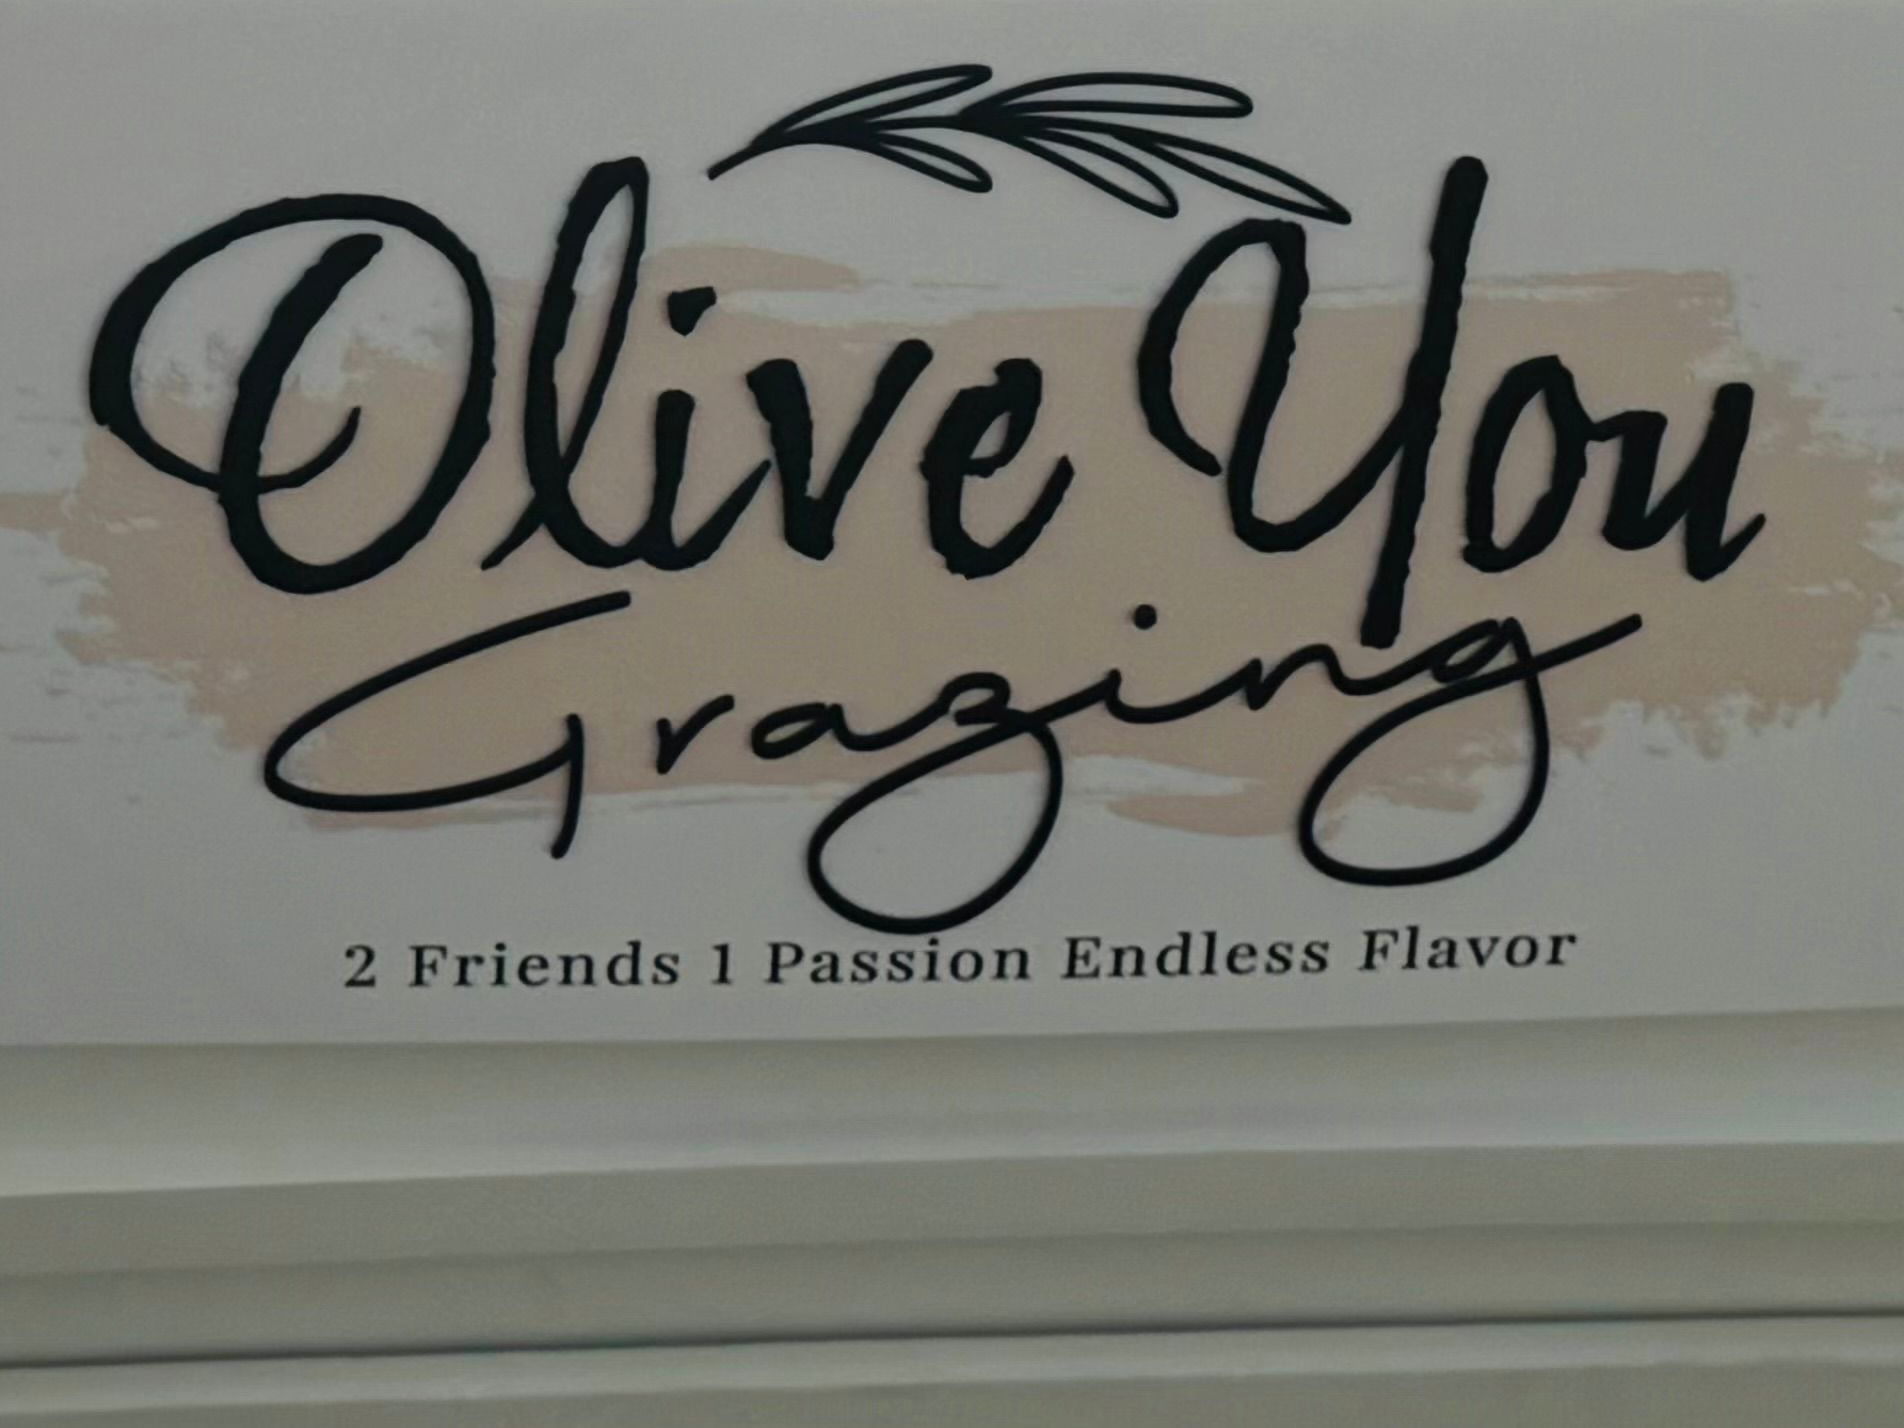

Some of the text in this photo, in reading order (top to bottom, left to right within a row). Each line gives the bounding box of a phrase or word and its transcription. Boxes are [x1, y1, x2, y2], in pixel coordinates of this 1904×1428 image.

[87, 155, 1767, 651] Olive You
[261, 589, 1644, 937] Grazing
[343, 924, 1578, 989] 2 Friends 1 Passion Endless Flavor
